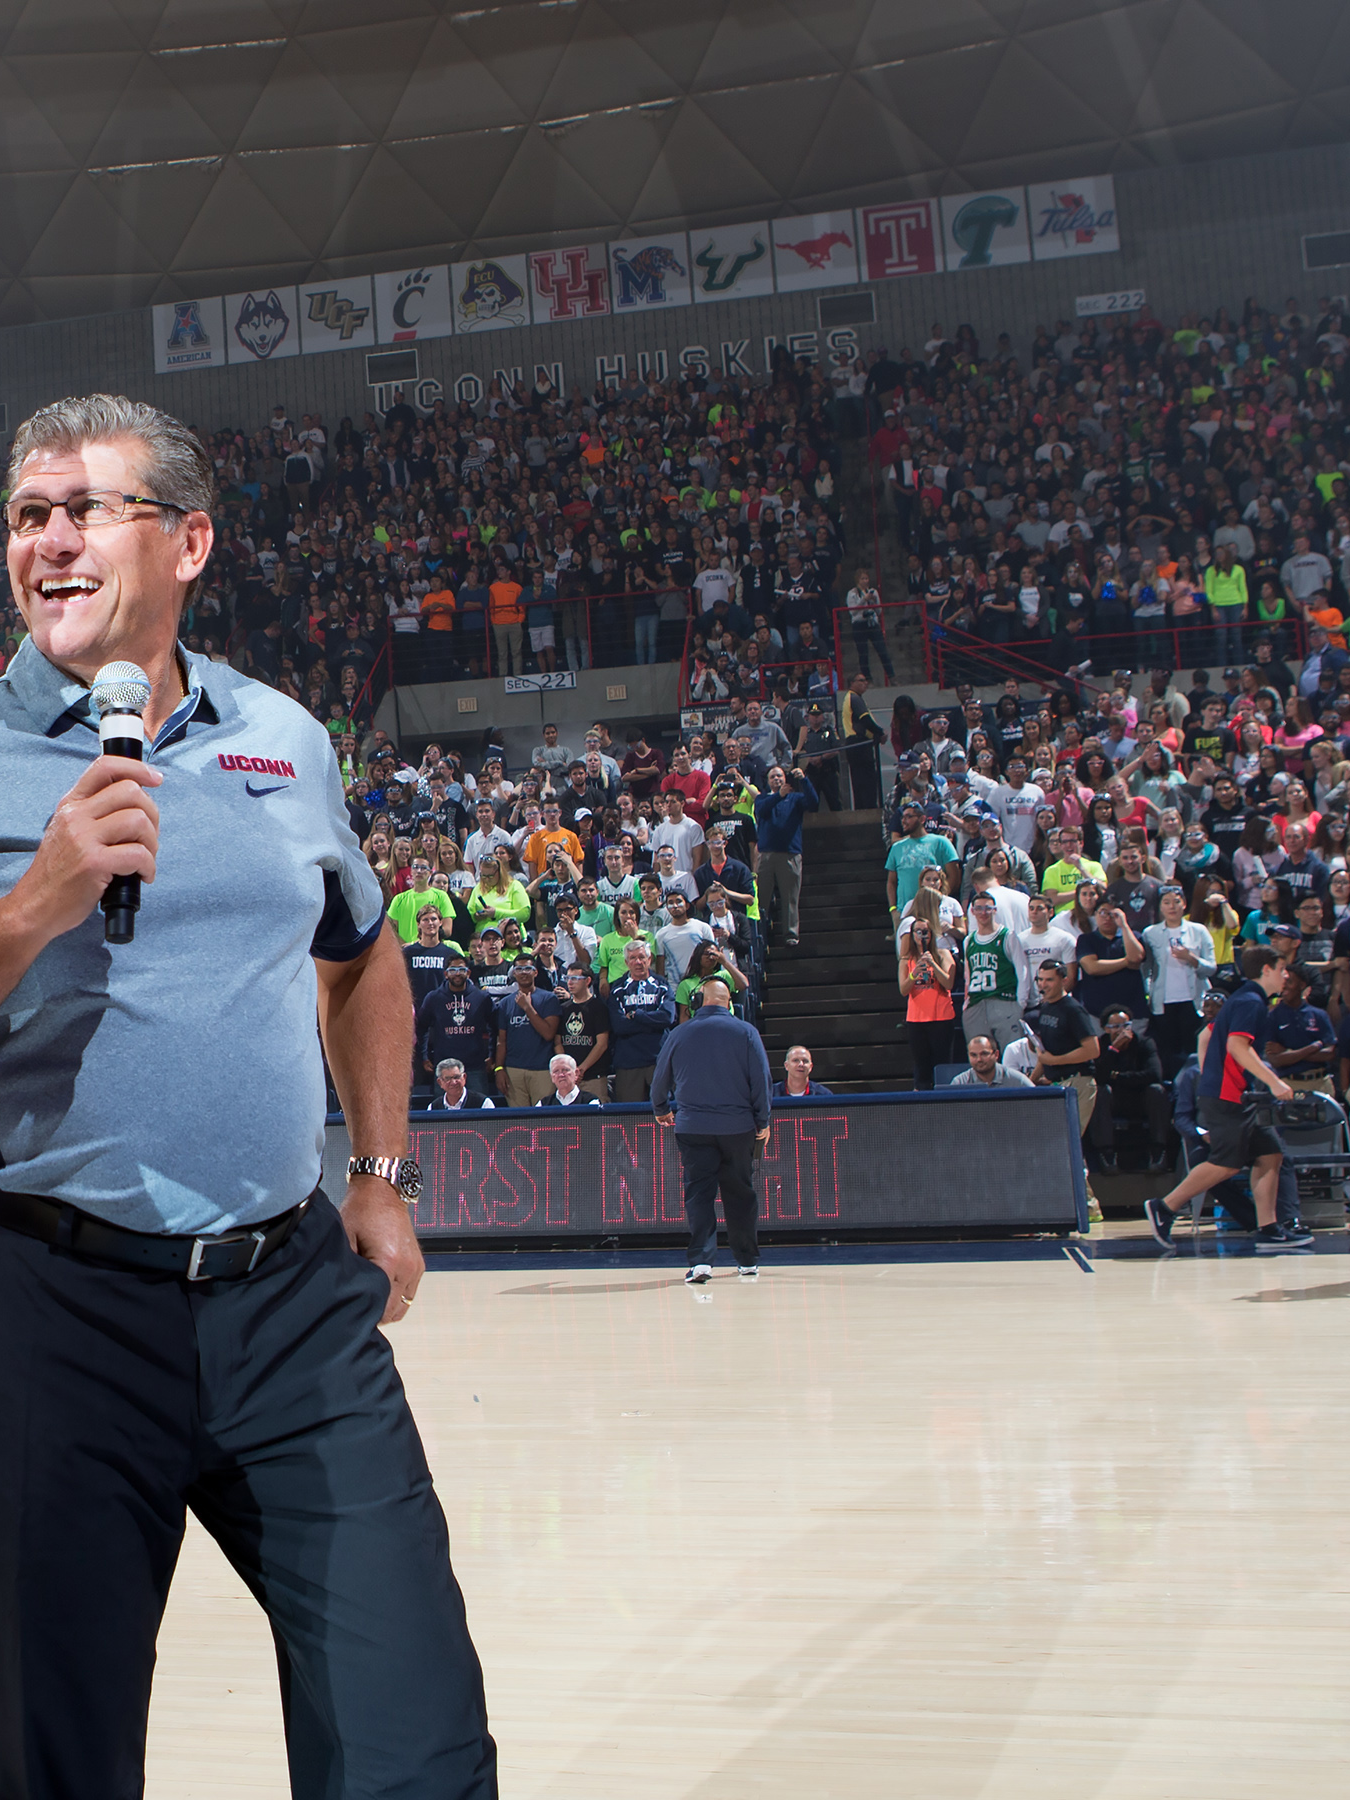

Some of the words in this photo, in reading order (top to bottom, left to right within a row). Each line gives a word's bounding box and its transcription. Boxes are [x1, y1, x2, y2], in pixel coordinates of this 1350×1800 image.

[1036, 203, 1115, 239] Tulsa
[473, 270, 495, 284] ECU
[1107, 292, 1144, 311] 222
[305, 290, 370, 340] UCF
[167, 351, 212, 365] AMERICAN
[374, 361, 565, 420] UCONN
[596, 329, 860, 394] HUSKIES
[507, 679, 531, 690] SEC
[540, 672, 575, 689] 221
[607, 687, 626, 700] EXIT
[458, 699, 476, 712] EXIT
[217, 754, 296, 779] UCONN
[412, 956, 444, 969] UCONN
[969, 951, 999, 971] CELTICS
[968, 970, 997, 993] 20
[444, 1025, 475, 1035] HUSKIES
[407, 1125, 581, 1228] IRST
[602, 1115, 848, 1223] NIHT
